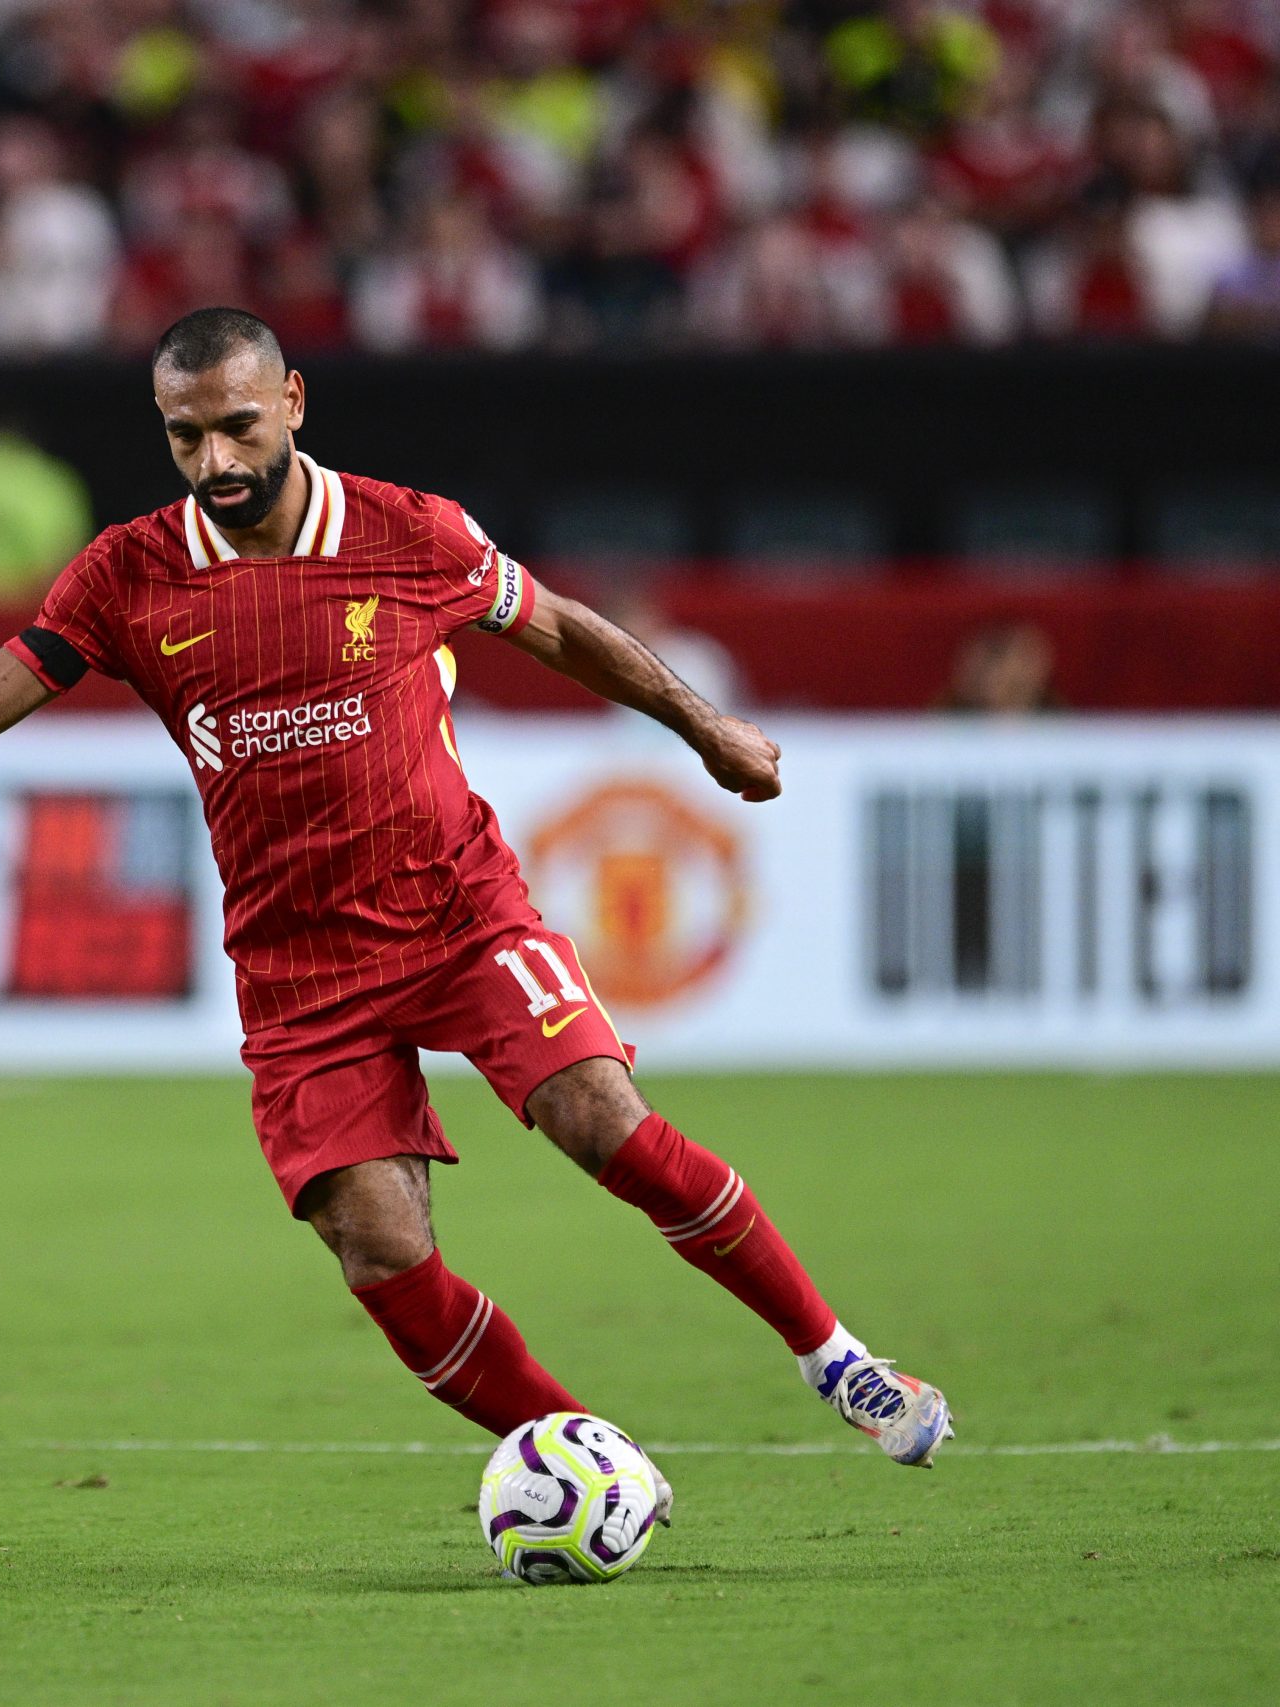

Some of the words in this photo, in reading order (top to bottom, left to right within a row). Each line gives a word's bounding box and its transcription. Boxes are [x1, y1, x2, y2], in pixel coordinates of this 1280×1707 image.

[228, 692, 363, 734] standard
[231, 712, 372, 758] chartered
[493, 938, 588, 1018] 11
